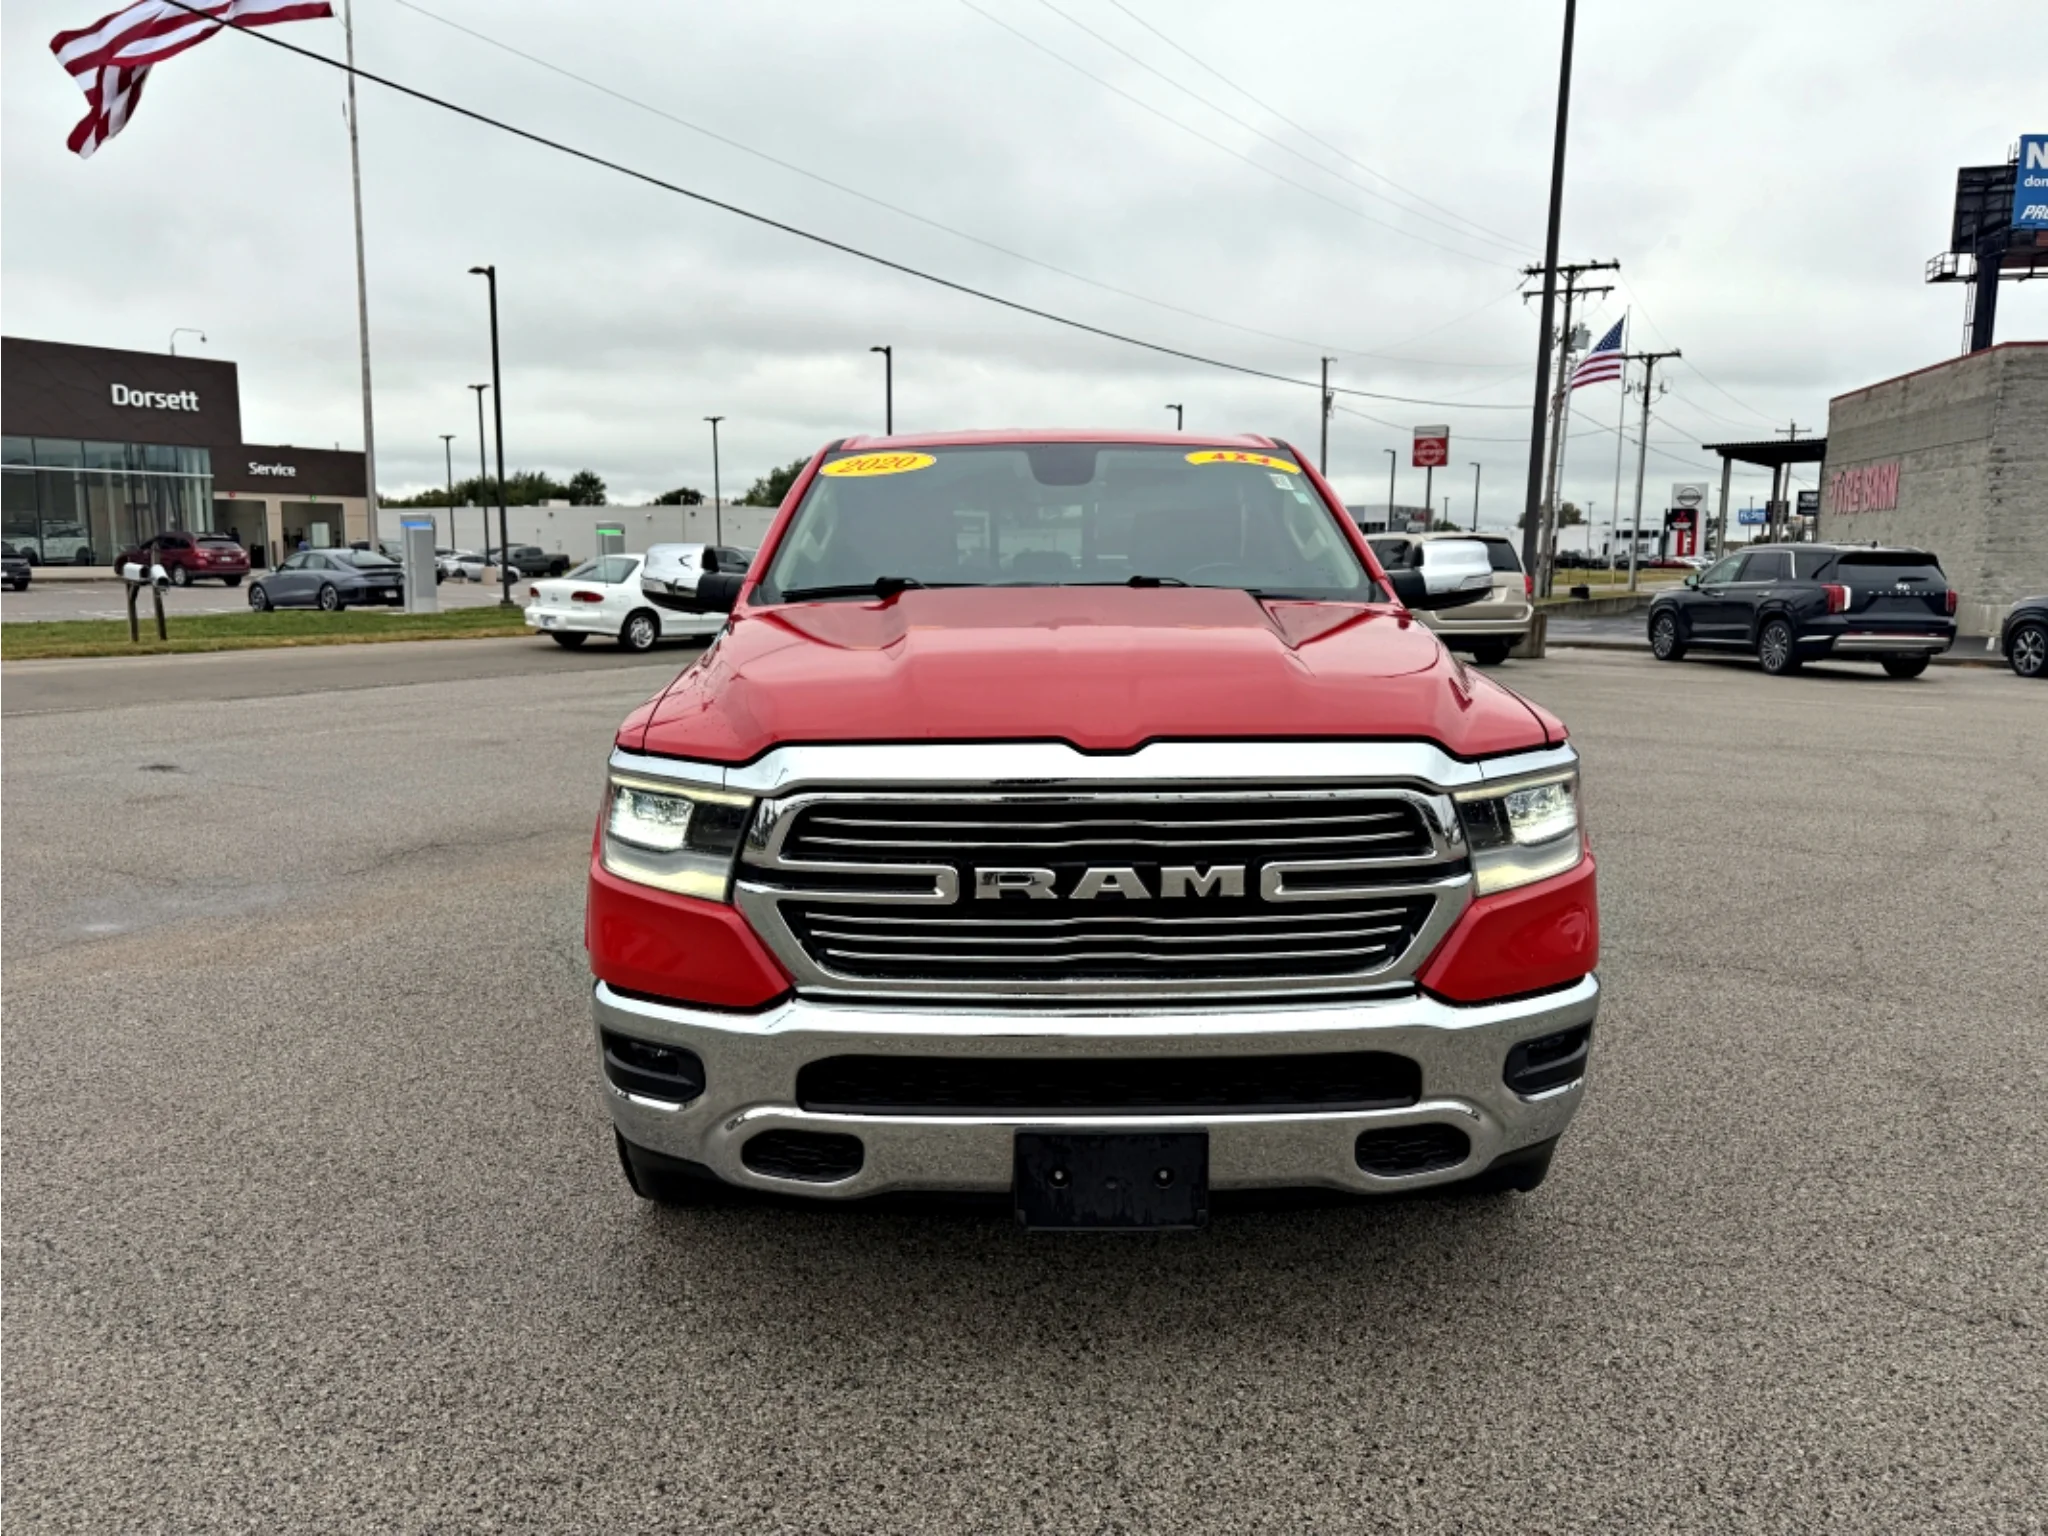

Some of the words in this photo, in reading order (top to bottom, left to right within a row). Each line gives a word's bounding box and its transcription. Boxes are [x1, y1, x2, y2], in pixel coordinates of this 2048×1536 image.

[111, 383, 200, 411] Dorsett
[248, 462, 296, 476] Service
[836, 456, 918, 473] 2020
[1829, 470, 1863, 515] TIRE
[974, 865, 1246, 899] RAM
